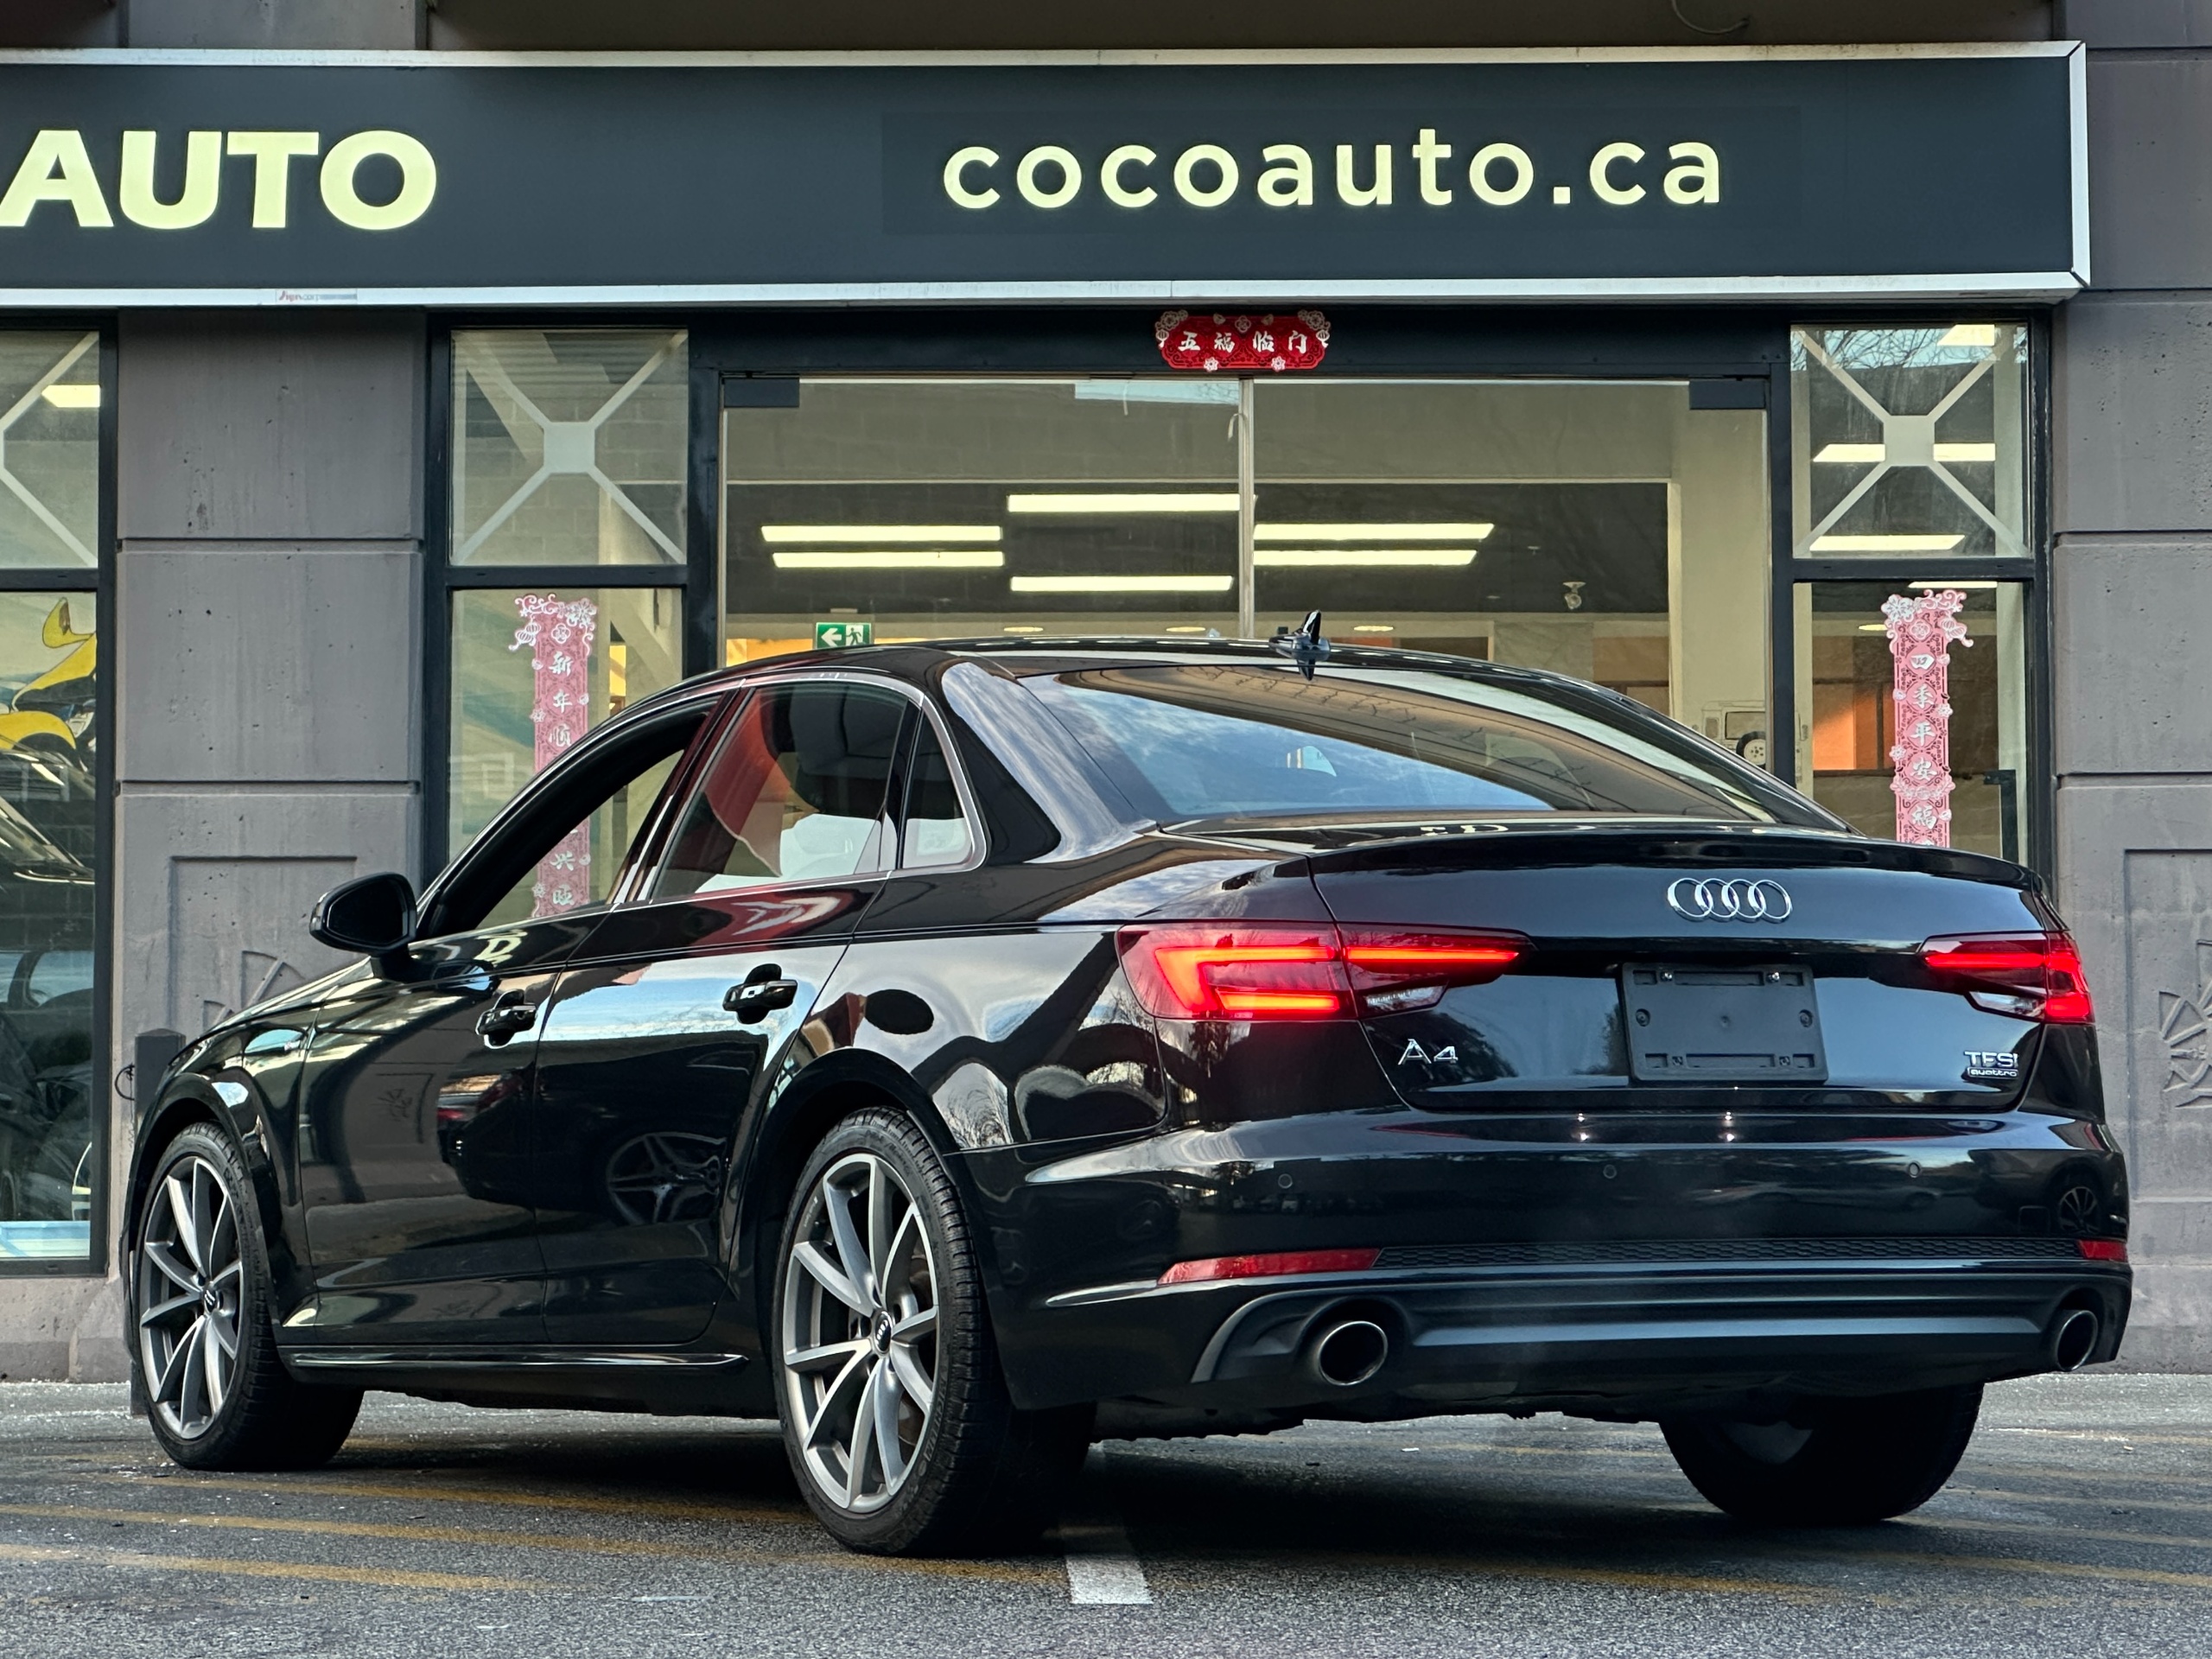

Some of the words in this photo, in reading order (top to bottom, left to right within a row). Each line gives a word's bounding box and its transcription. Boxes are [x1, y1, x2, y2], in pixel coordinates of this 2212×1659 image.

[0, 130, 437, 231] AUTO
[942, 128, 1721, 210] cocoauto.ca
[1178, 330, 1308, 354] 五福临门
[1910, 653, 1938, 844] 四季平安福
[1397, 1038, 1459, 1065] A4
[1963, 1051, 2019, 1068] TFSI
[1970, 1069, 2018, 1077] quattro
